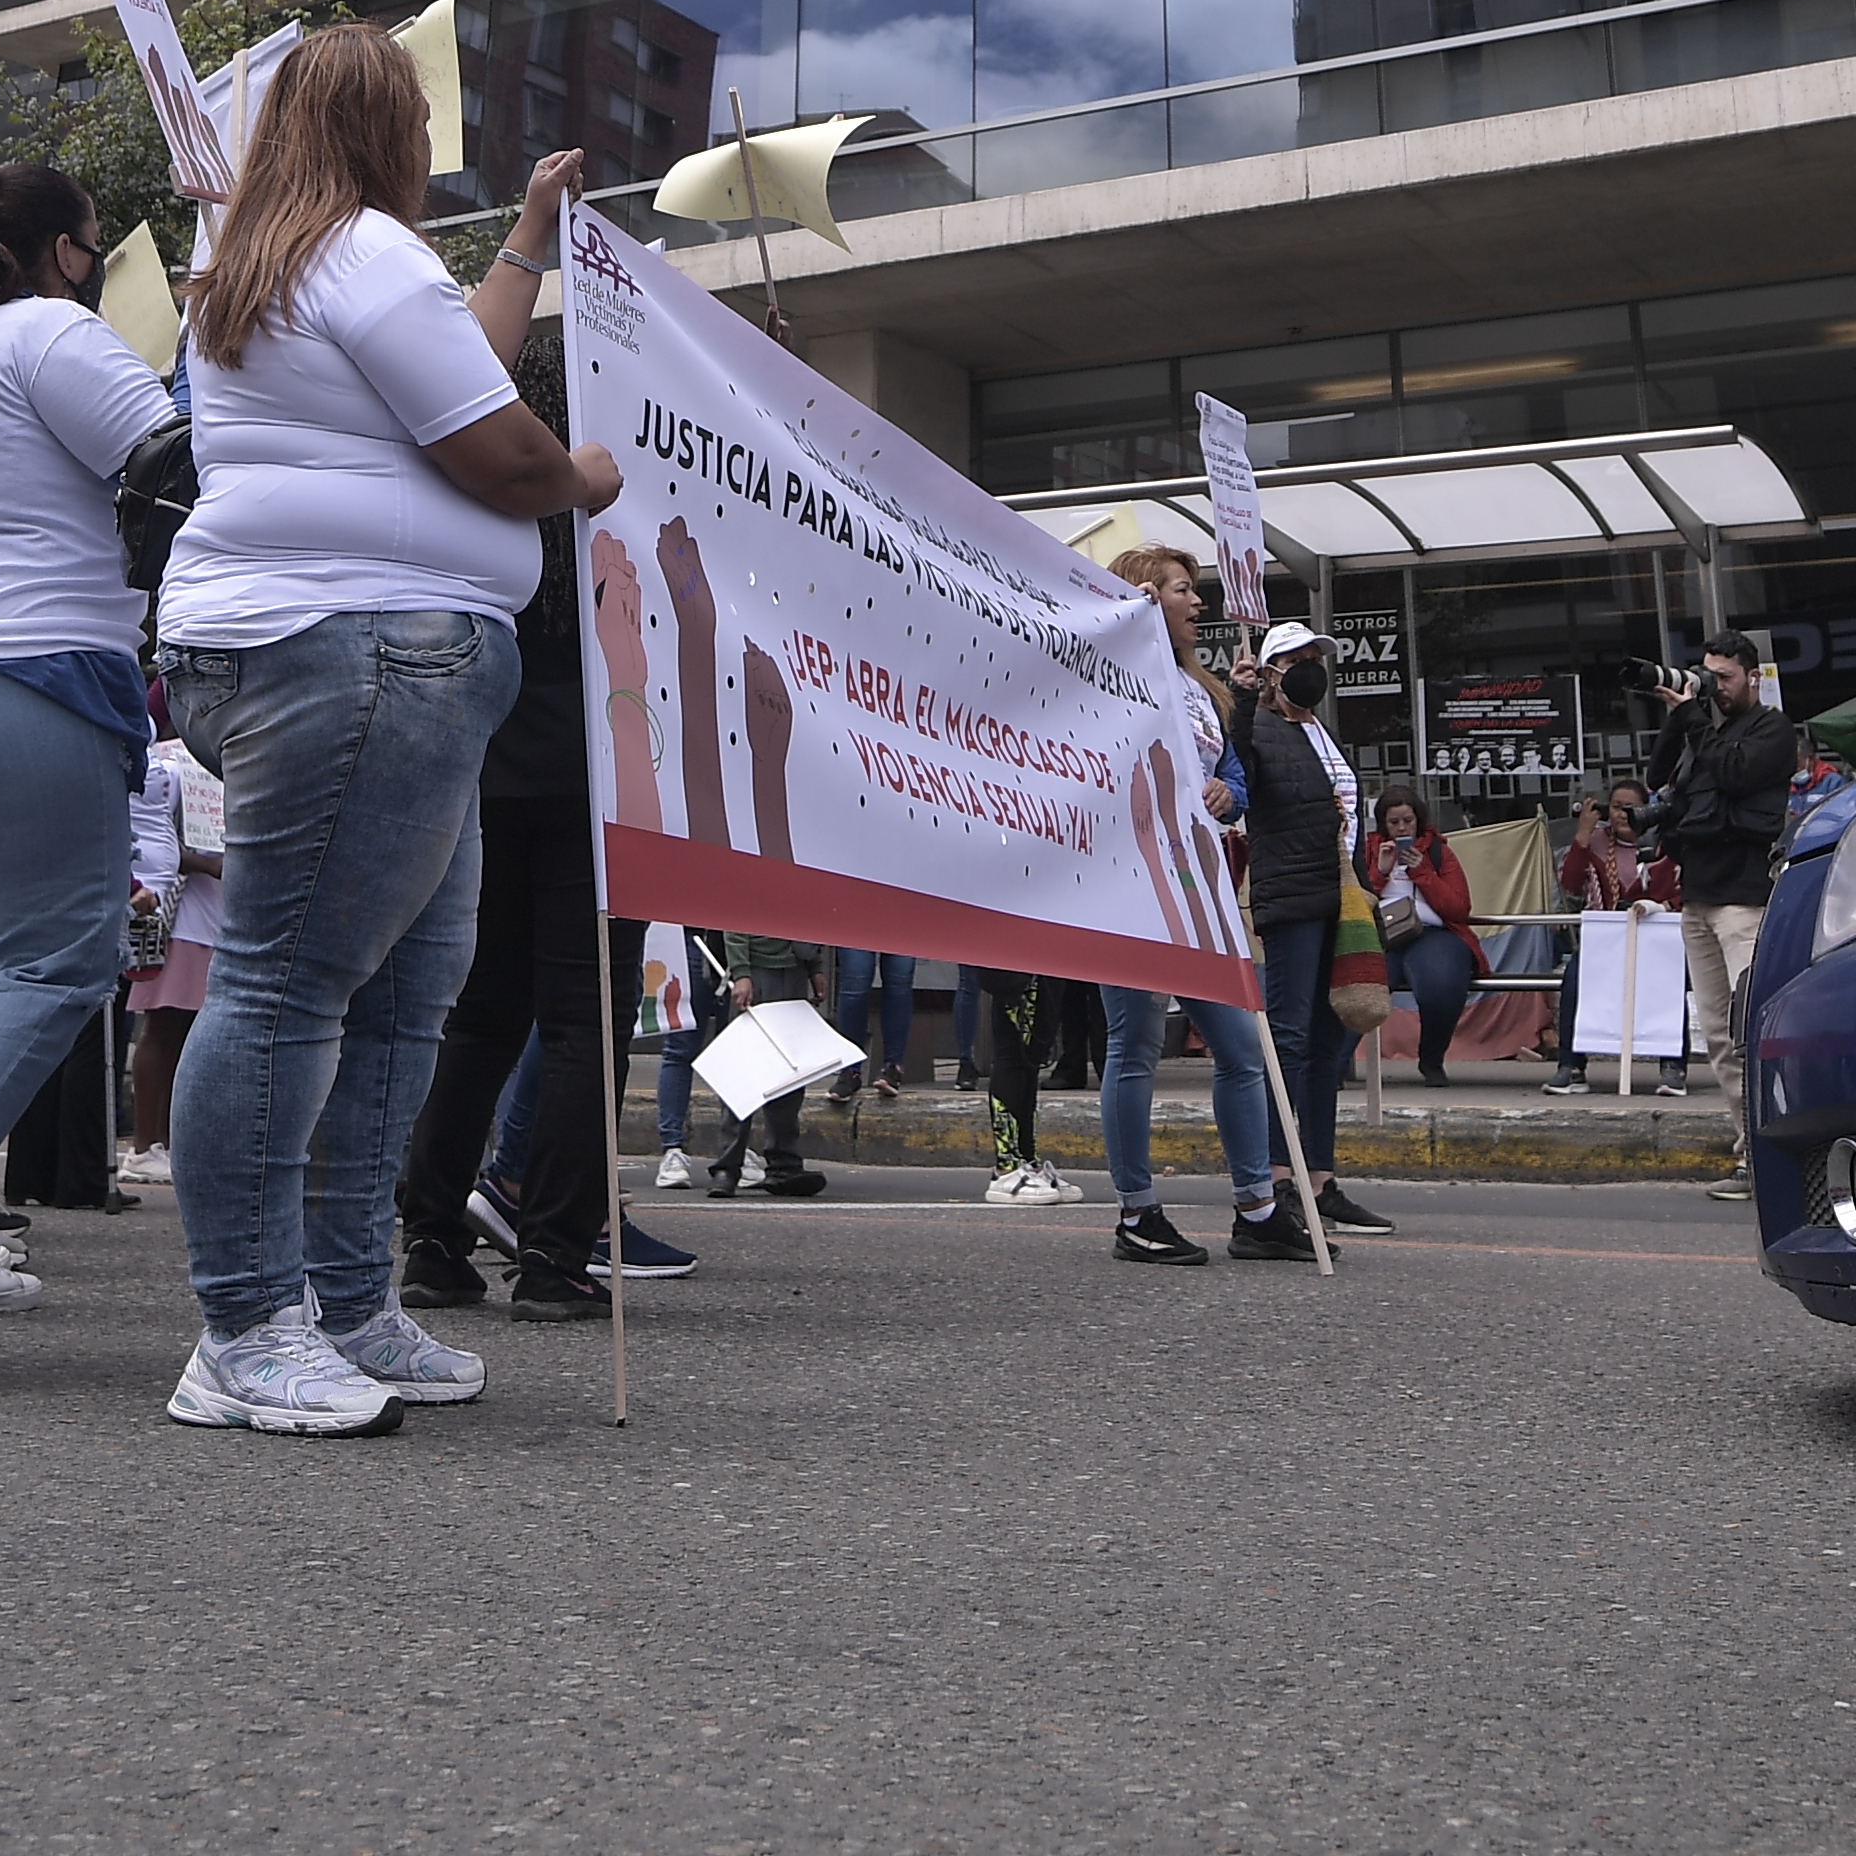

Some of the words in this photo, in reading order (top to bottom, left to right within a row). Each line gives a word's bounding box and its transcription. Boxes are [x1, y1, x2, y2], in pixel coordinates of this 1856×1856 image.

[592, 283, 604, 302] de
[605, 290, 646, 324] Mujeres
[576, 308, 640, 355] Profesionales
[628, 322, 636, 336] y
[635, 397, 772, 511] JUSTICIA
[782, 469, 854, 550] PARA
[856, 514, 905, 575] LAS
[999, 600, 1031, 644] DE
[1031, 618, 1096, 688] VIOLENCIA
[1099, 657, 1160, 711] SEXUAL
[1334, 615, 1398, 631] SOTROS
[1337, 634, 1399, 663] PAZ
[783, 629, 834, 693] ¡JEP
[846, 652, 910, 729] ABRA
[915, 684, 941, 742] EL
[945, 697, 1086, 783] MACROCASO
[1083, 748, 1116, 795] DE
[848, 728, 988, 821] VIOLENCIA
[982, 779, 1064, 846] SEXUAL
[1065, 802, 1093, 857] YA!
[252, 1358, 283, 1384] N
[373, 1343, 402, 1368] N
